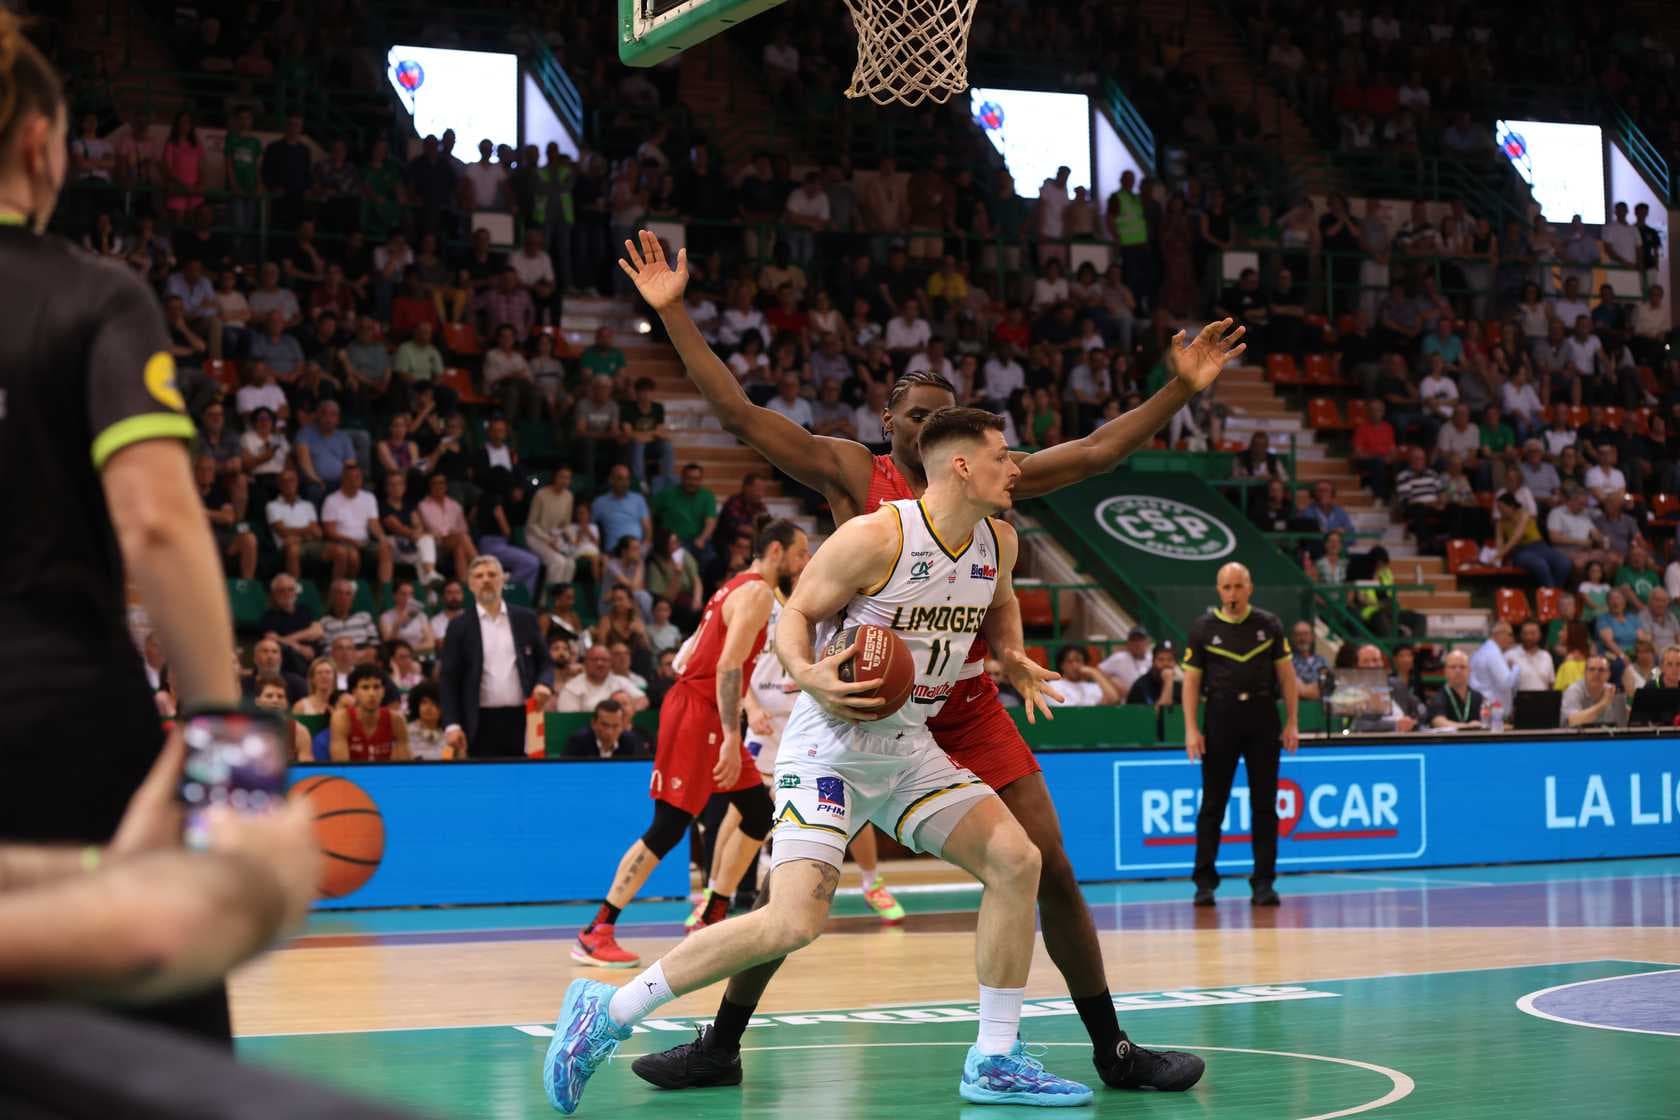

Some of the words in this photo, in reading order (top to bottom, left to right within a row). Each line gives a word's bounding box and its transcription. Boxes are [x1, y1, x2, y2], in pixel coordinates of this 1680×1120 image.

[1115, 508, 1210, 540] CSP
[891, 606, 986, 633] LIMOGES
[925, 638, 952, 677] 11
[816, 804, 846, 817] PHM
[1142, 786, 1251, 835] RET
[1308, 782, 1399, 829] CAR
[1544, 773, 1616, 829] LA
[1630, 771, 1680, 826] LI
